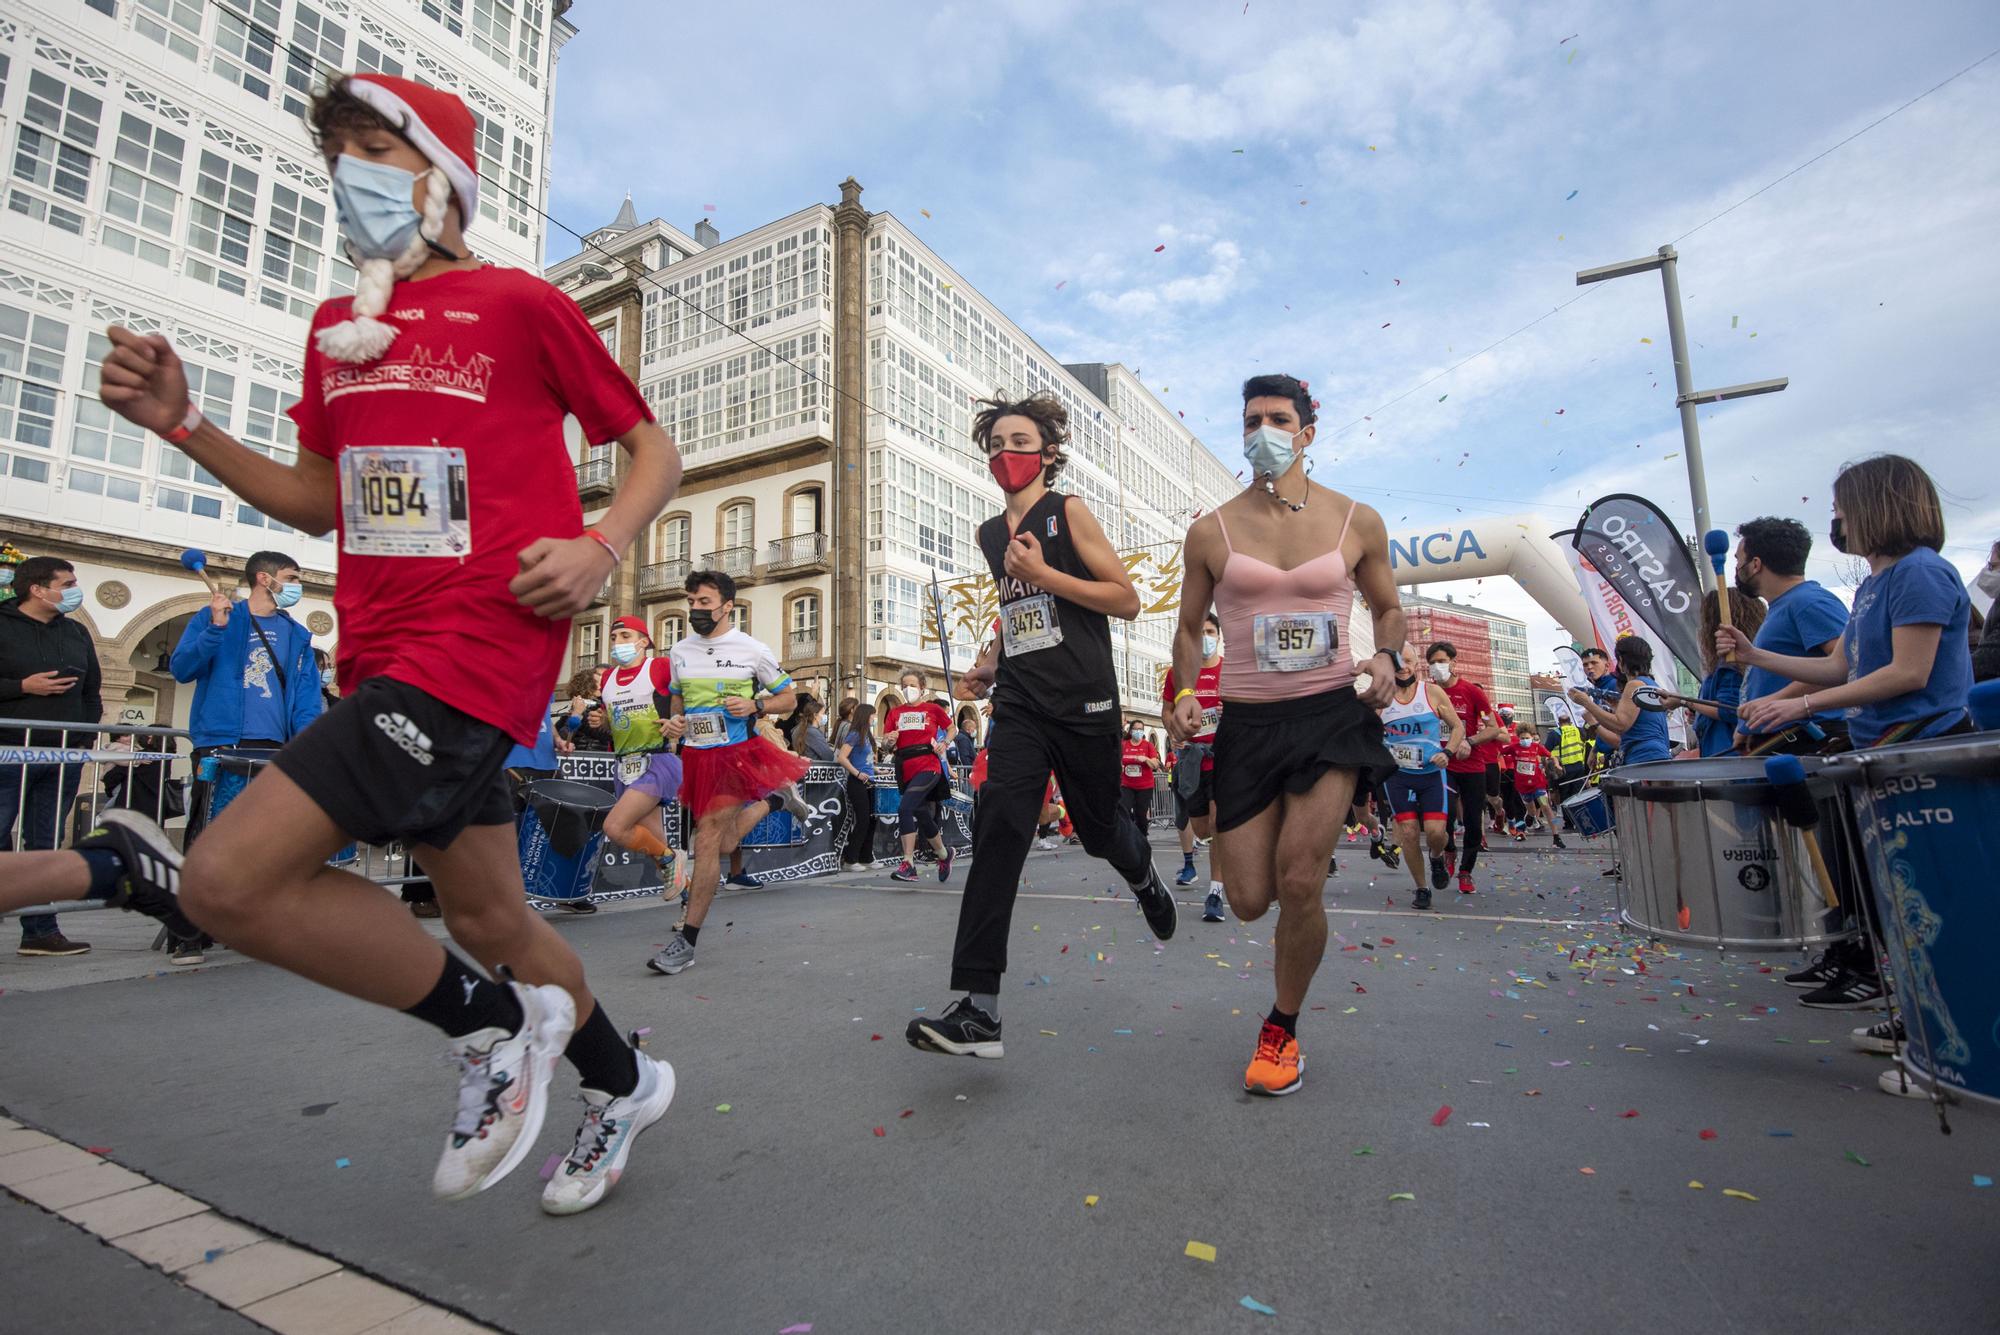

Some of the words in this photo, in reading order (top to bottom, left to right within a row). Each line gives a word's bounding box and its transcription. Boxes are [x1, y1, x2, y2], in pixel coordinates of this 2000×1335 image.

[444, 310, 479, 322] CASTRO
[361, 476, 428, 516] 1094
[1389, 529, 1487, 569] NCA
[1010, 610, 1044, 636] 3473
[1278, 629, 1314, 650] 957
[693, 722, 714, 735] 880
[374, 713, 435, 766] adidas
[7, 750, 93, 763] ABANCA
[1398, 750, 1412, 760] 541
[626, 762, 642, 775] 879
[1895, 807, 1955, 828] ALTO
[1722, 849, 1780, 861] TIMBRA
